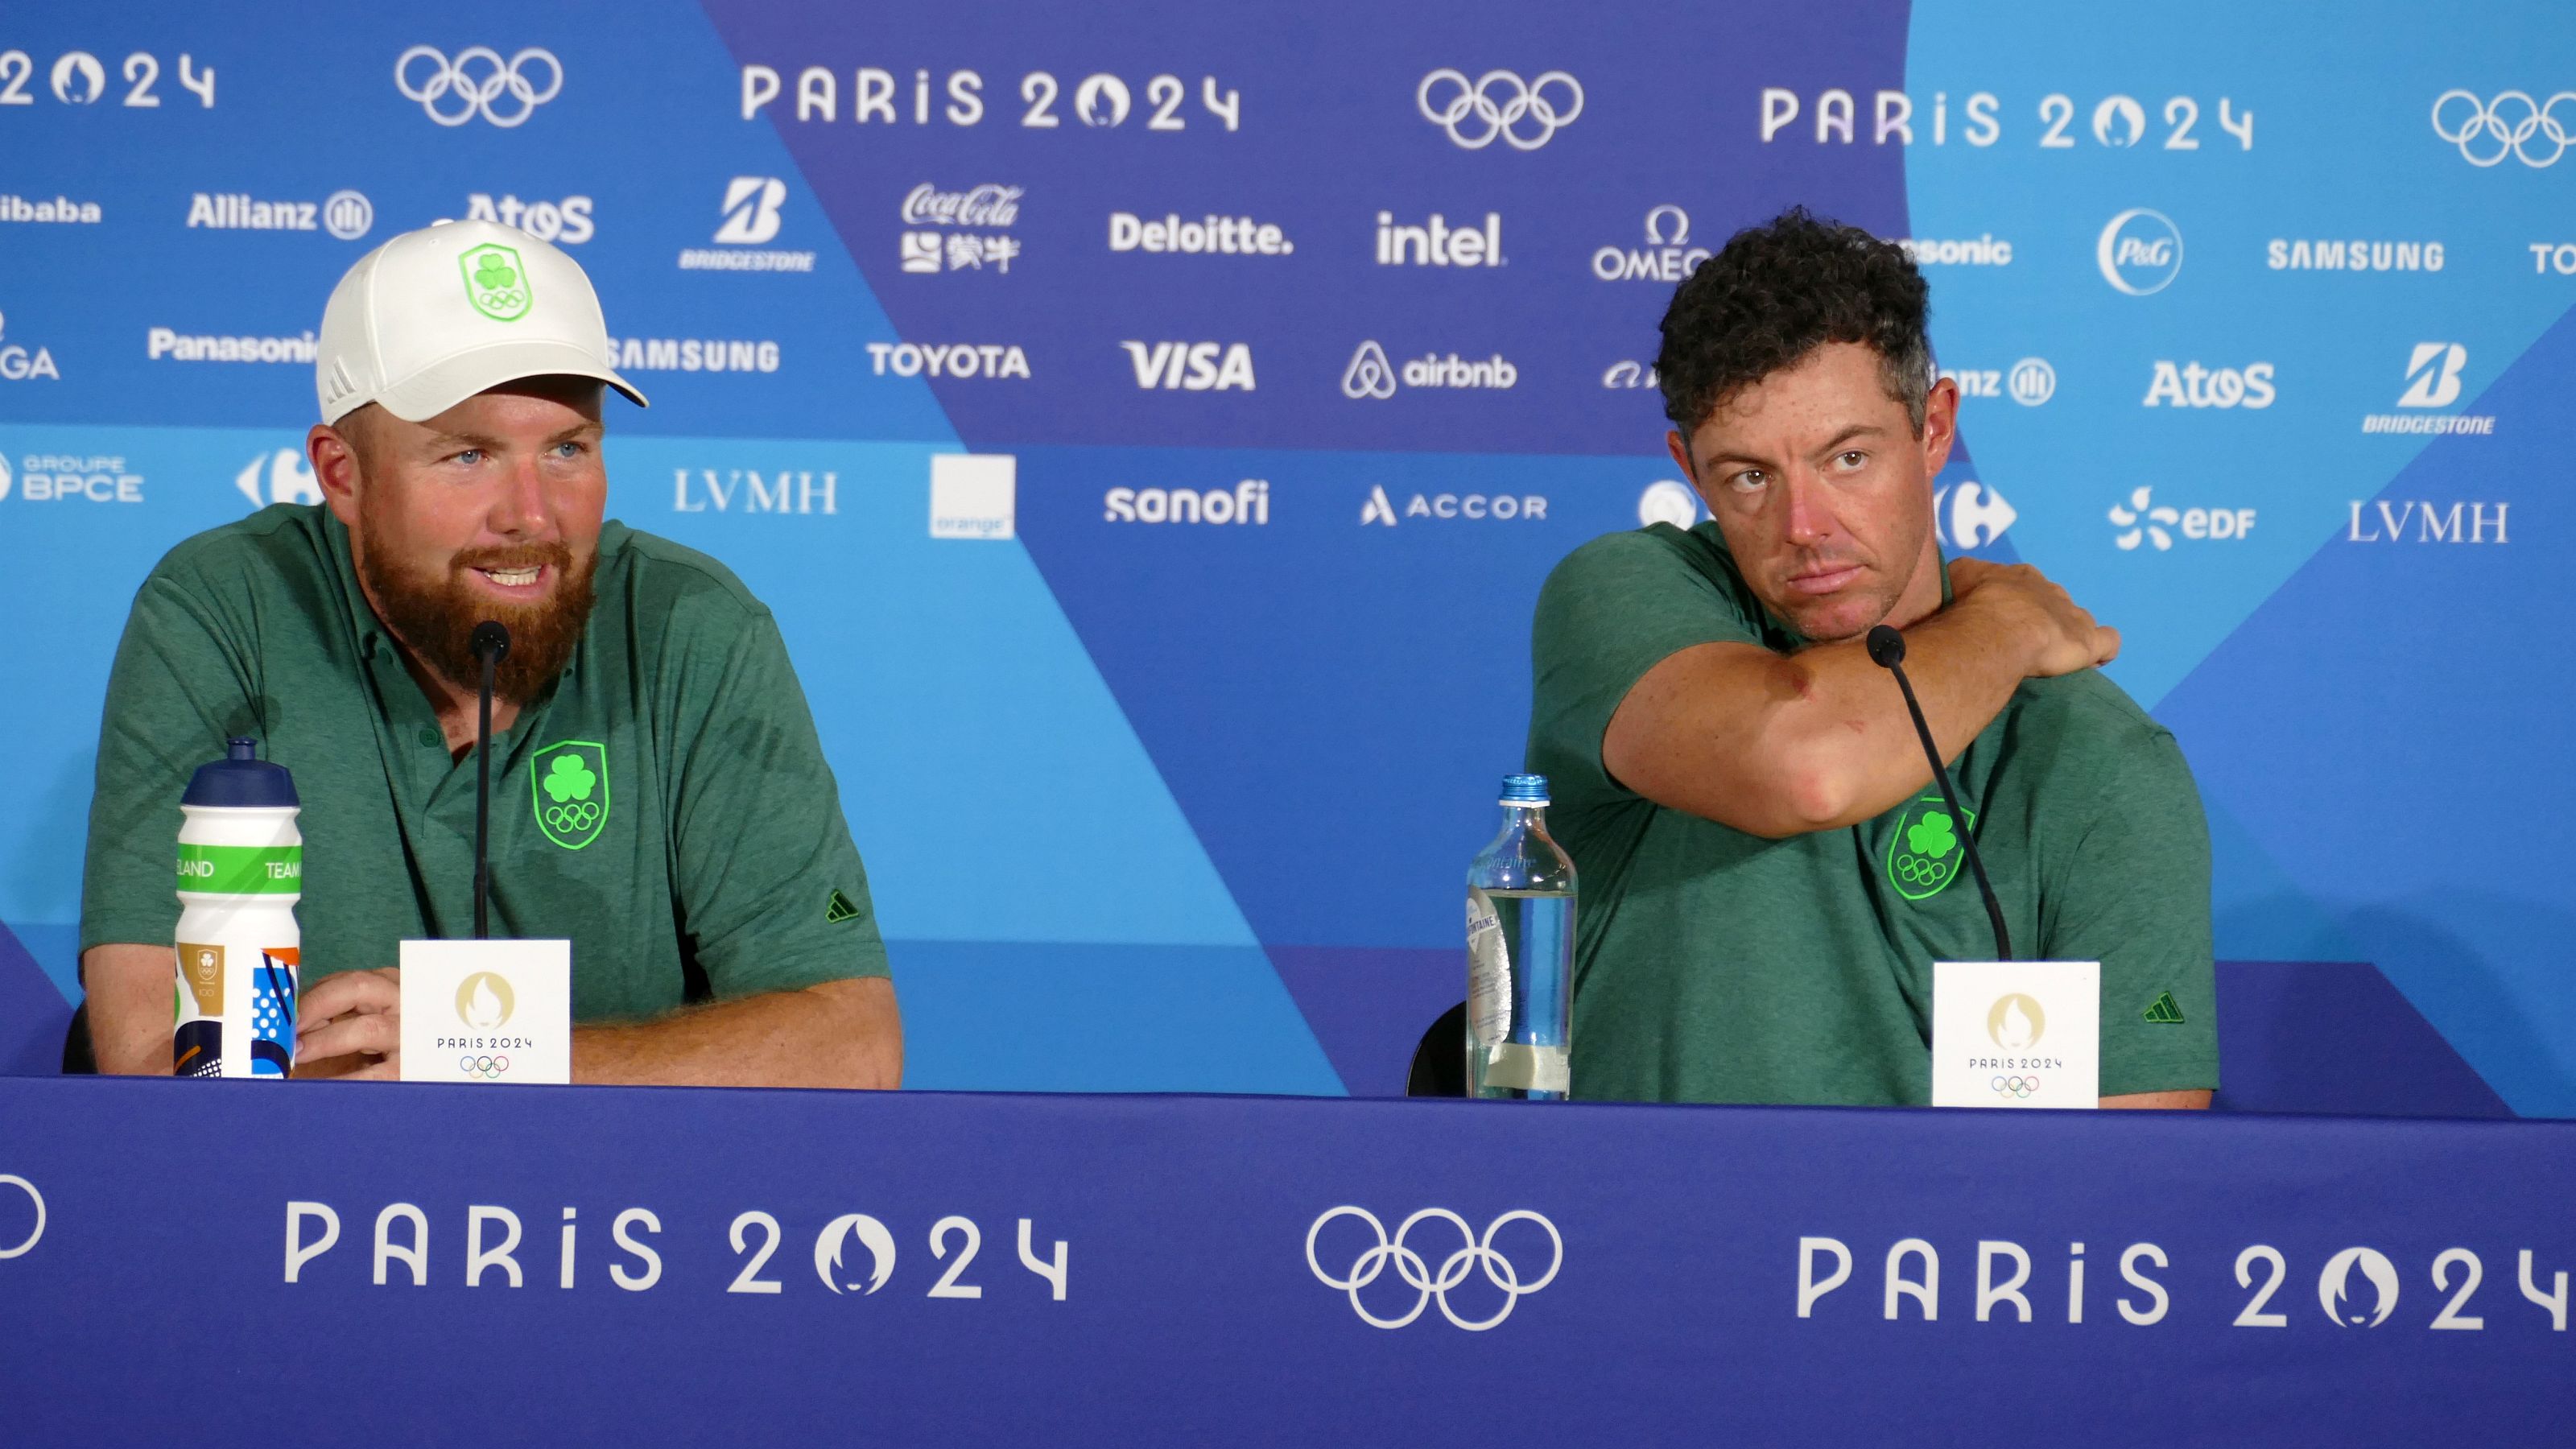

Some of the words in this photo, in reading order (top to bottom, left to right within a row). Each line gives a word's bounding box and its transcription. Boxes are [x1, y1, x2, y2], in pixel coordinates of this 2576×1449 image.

[1021, 72, 1240, 131] 2024
[2039, 93, 2254, 151] 2024
[187, 193, 317, 230] Allianz
[679, 250, 815, 272] BRIDGESTONE
[2116, 236, 2174, 266] P&G
[2268, 239, 2445, 271] SAMSUNG
[148, 328, 320, 364] Panasoni
[867, 343, 1030, 378] TOYOTA
[1121, 340, 1256, 392] VISA
[1402, 353, 1517, 389] airbnb
[2362, 415, 2495, 436] BRIDGESTONE
[23, 456, 127, 473] GROUPE
[22, 473, 144, 502] BPCE
[674, 469, 838, 515] LVMH
[1104, 479, 1269, 525] sanofi
[1406, 493, 1547, 519] ACCOR
[2348, 500, 2509, 544] LVMH
[935, 515, 1004, 535] orange
[266, 862, 299, 879] TEAM
[490, 1038, 532, 1048] 2024
[2021, 1059, 2062, 1069] 2024
[727, 1210, 1068, 1301] 2024
[2232, 1245, 2570, 1332] 2024
